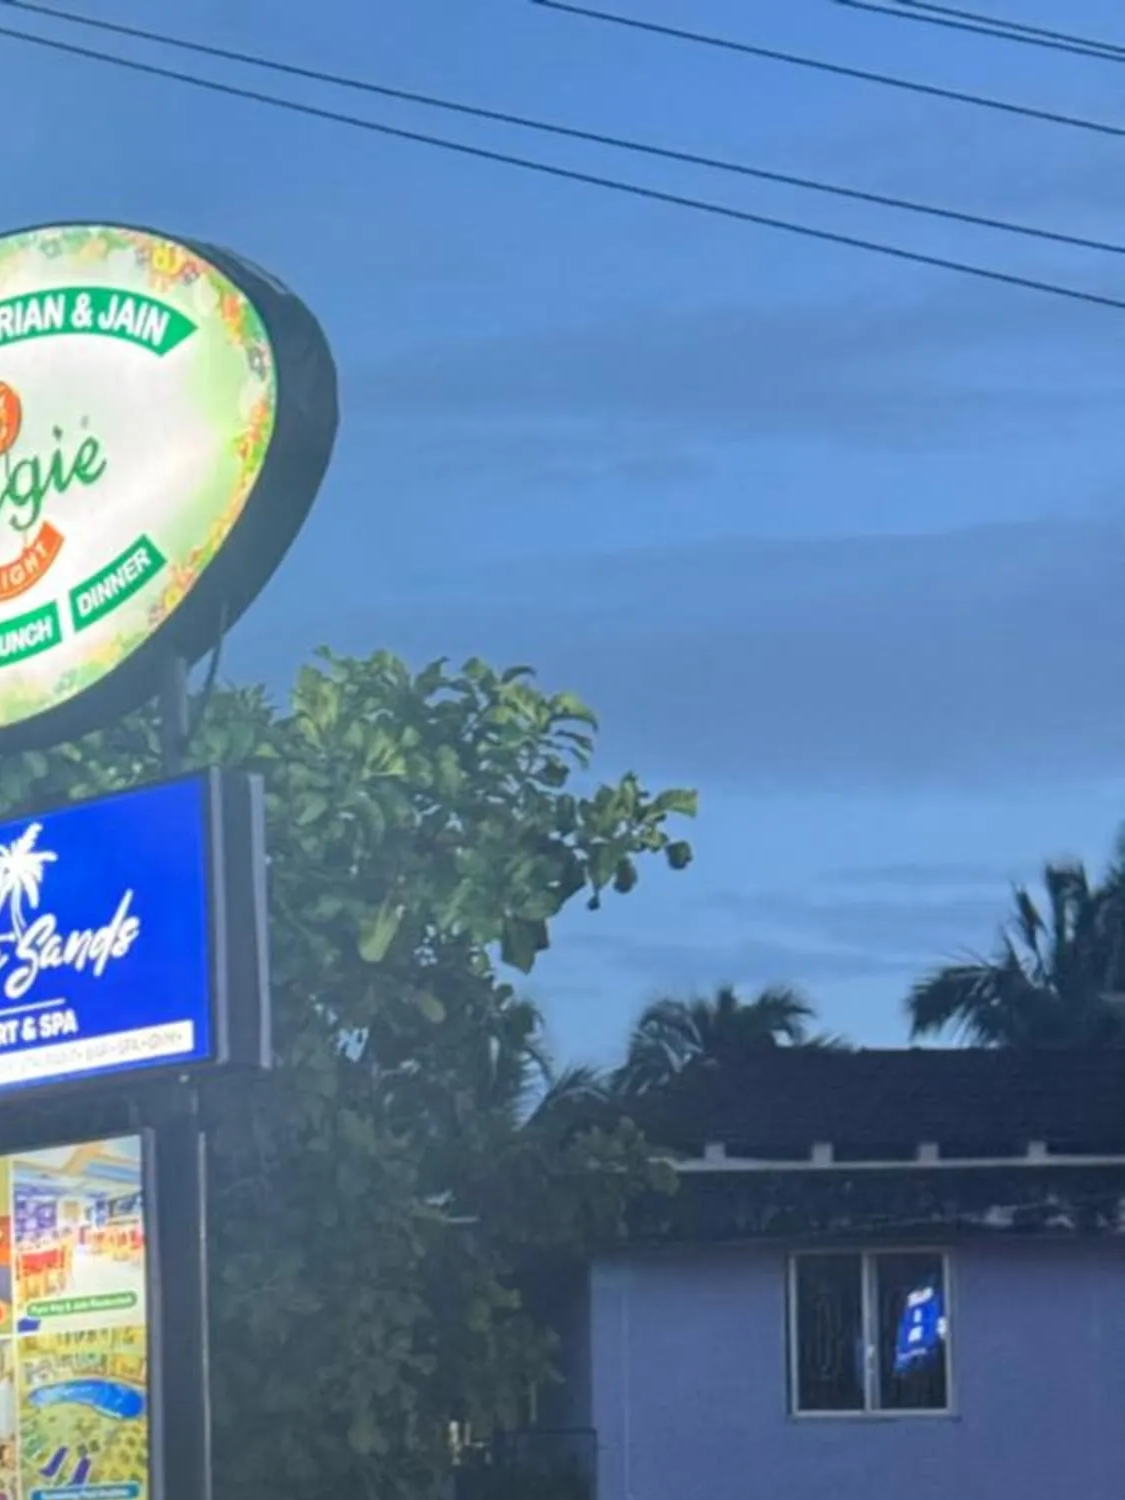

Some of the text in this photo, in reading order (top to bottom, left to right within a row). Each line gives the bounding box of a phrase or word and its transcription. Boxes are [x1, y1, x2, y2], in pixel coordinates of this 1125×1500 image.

[71, 294, 94, 328] &
[98, 295, 170, 348] JAIN
[77, 548, 151, 616] DINNER
[5, 889, 140, 999] Sands
[21, 1016, 36, 1042] &
[39, 1009, 79, 1038] SPA
